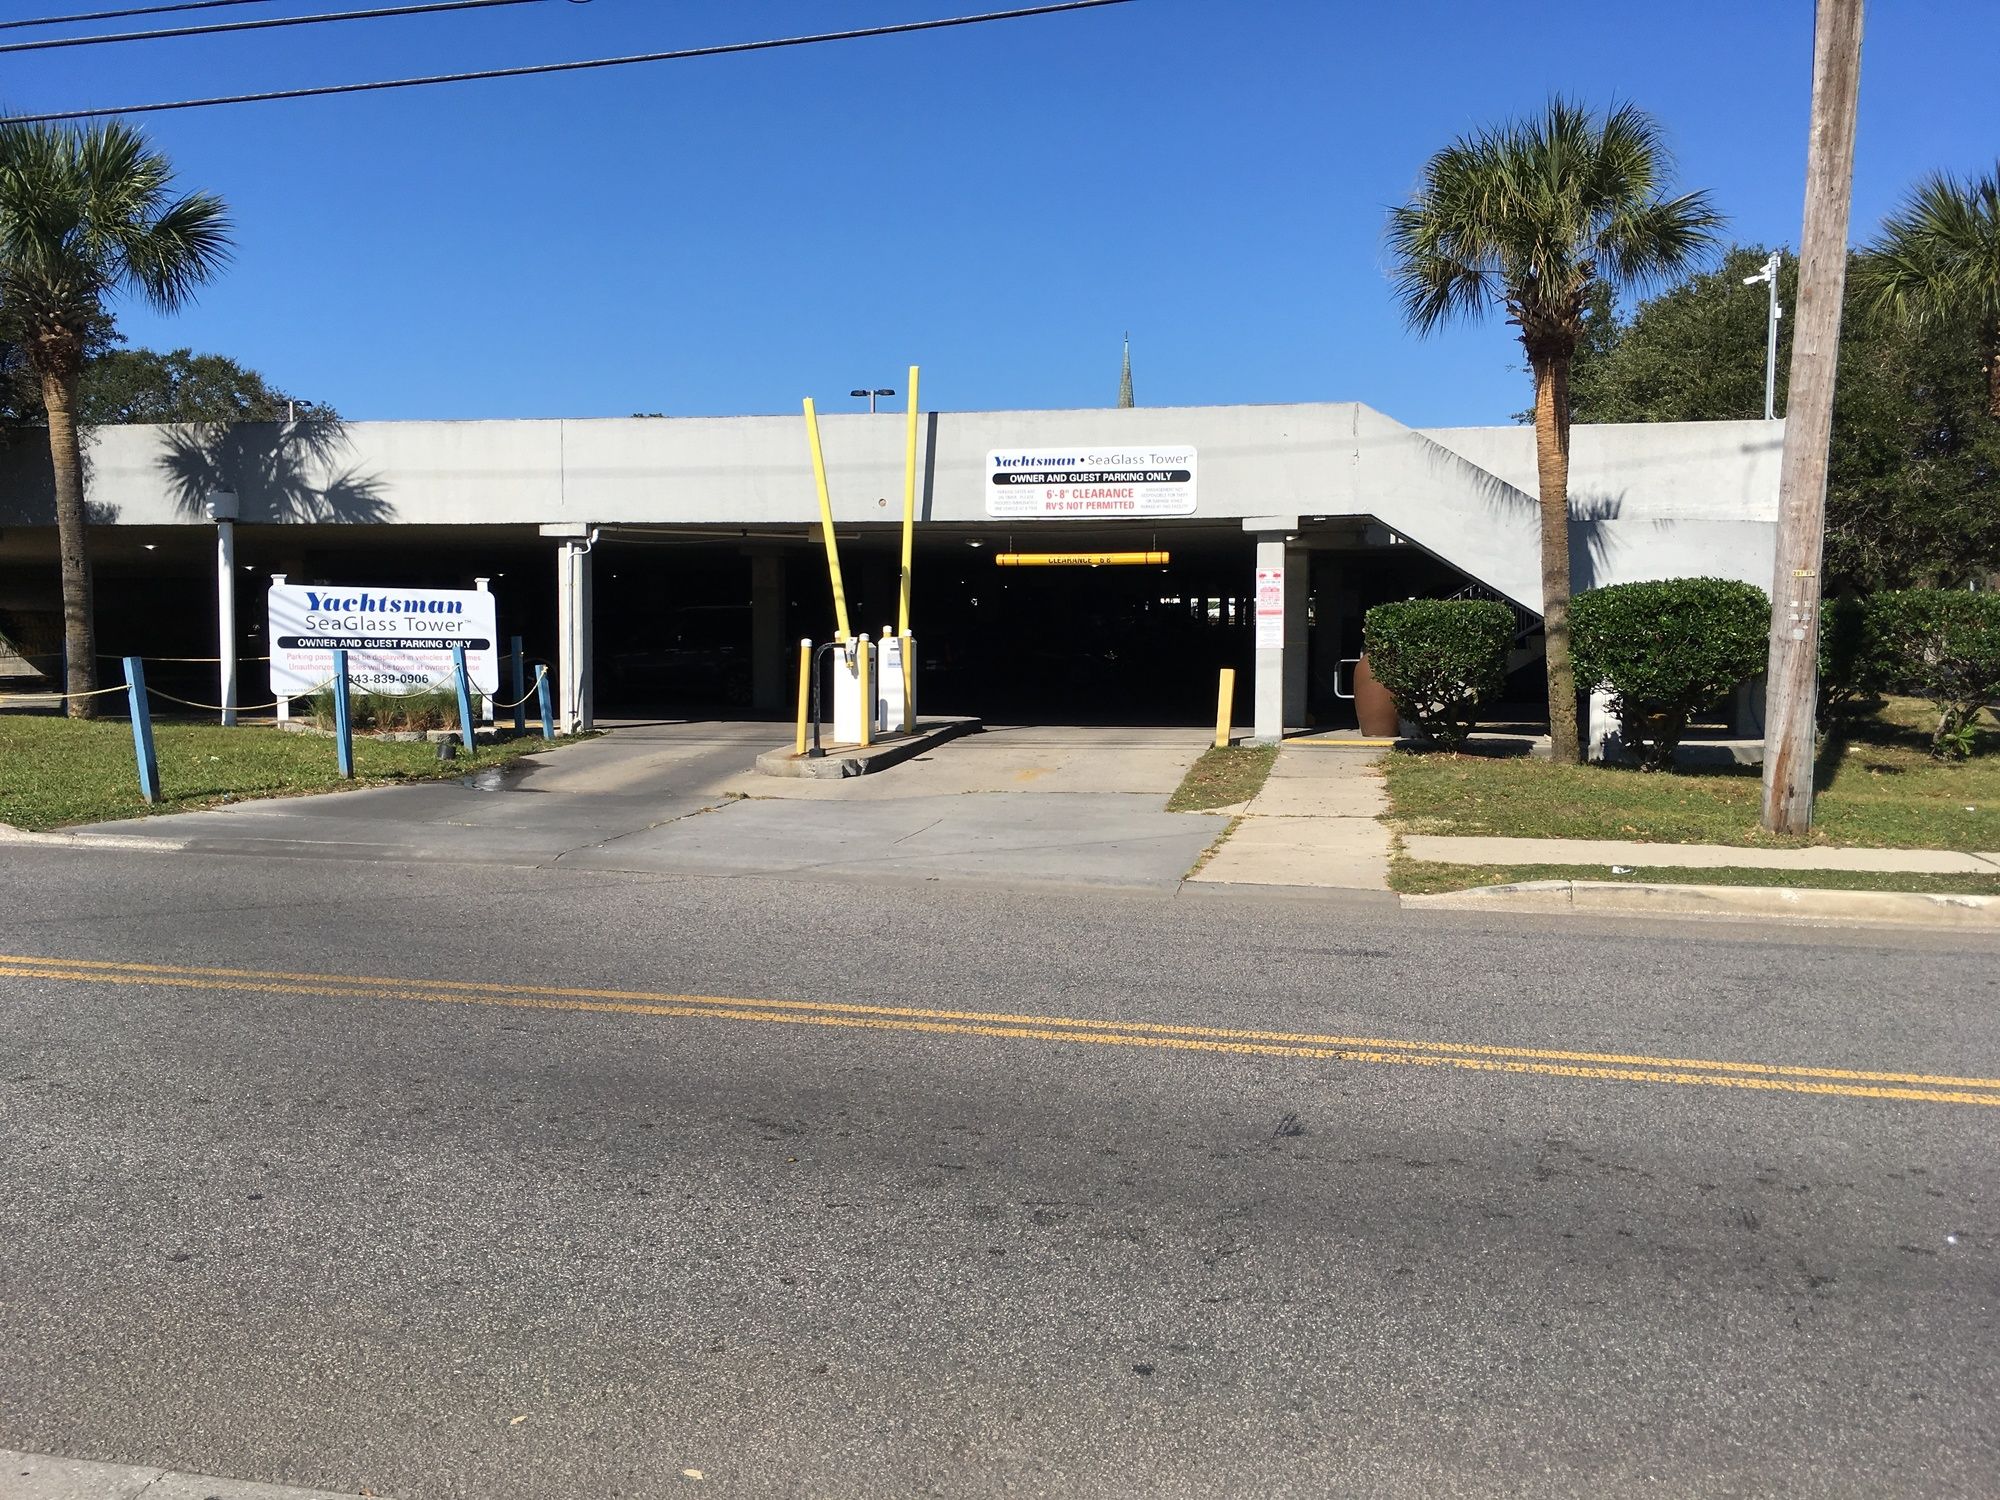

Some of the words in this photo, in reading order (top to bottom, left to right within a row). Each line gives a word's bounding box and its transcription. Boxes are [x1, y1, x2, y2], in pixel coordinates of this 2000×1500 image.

[994, 456, 1076, 467] Yachtsman
[1088, 454, 1145, 465] SeaGlass
[1009, 474, 1045, 483] OWNER
[1046, 474, 1067, 483] AND
[1068, 473, 1100, 482] GUEST
[1102, 473, 1143, 482] PARKING
[1146, 472, 1173, 481] ONLY
[1072, 488, 1134, 498] CLEARANCE
[1045, 502, 1061, 510] RV'S
[1063, 502, 1083, 510] NOT
[1086, 501, 1135, 510] PERMITTED
[306, 592, 463, 614] Yachtsman
[306, 615, 397, 631] SeaGlass
[298, 638, 337, 647] OWNER
[339, 639, 361, 648] AND
[364, 639, 398, 648] GUEST
[401, 640, 443, 648] PARKING
[445, 640, 472, 648] ONLY
[287, 653, 313, 662] Parking
